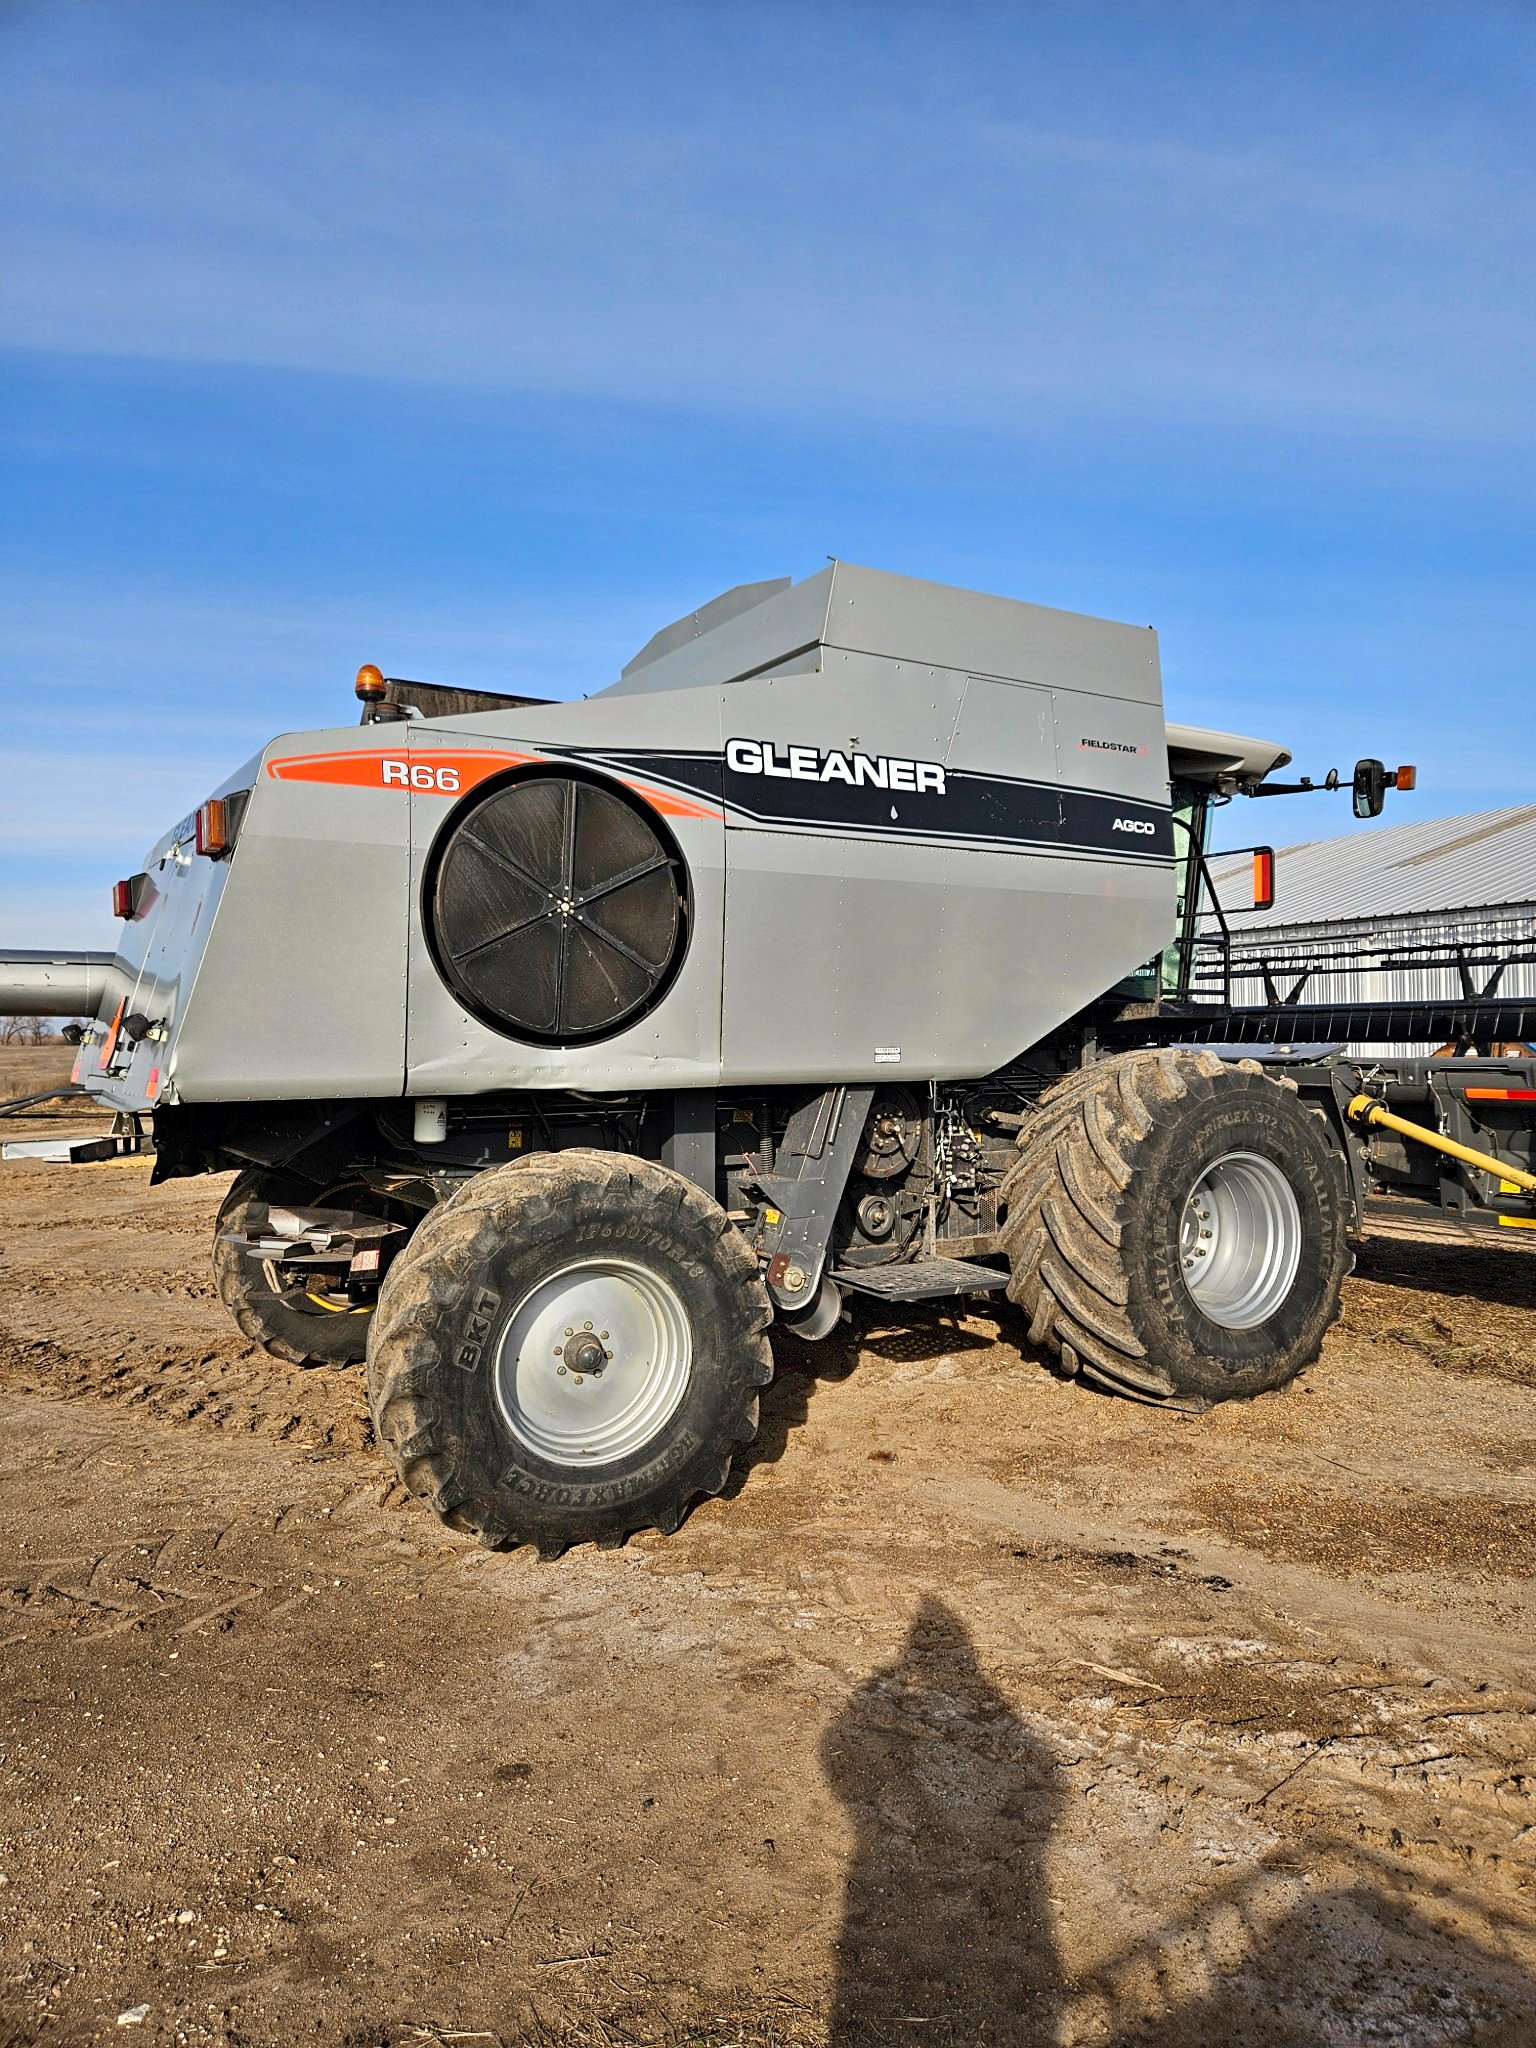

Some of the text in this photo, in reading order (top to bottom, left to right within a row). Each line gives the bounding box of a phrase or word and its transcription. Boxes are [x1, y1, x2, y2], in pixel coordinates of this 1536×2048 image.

[1081, 739, 1137, 754] FIELDSTAR
[382, 760, 460, 791] R66
[726, 738, 946, 795] GLEANER
[1112, 819, 1155, 835] AGCO
[455, 1287, 501, 1372] BKT
